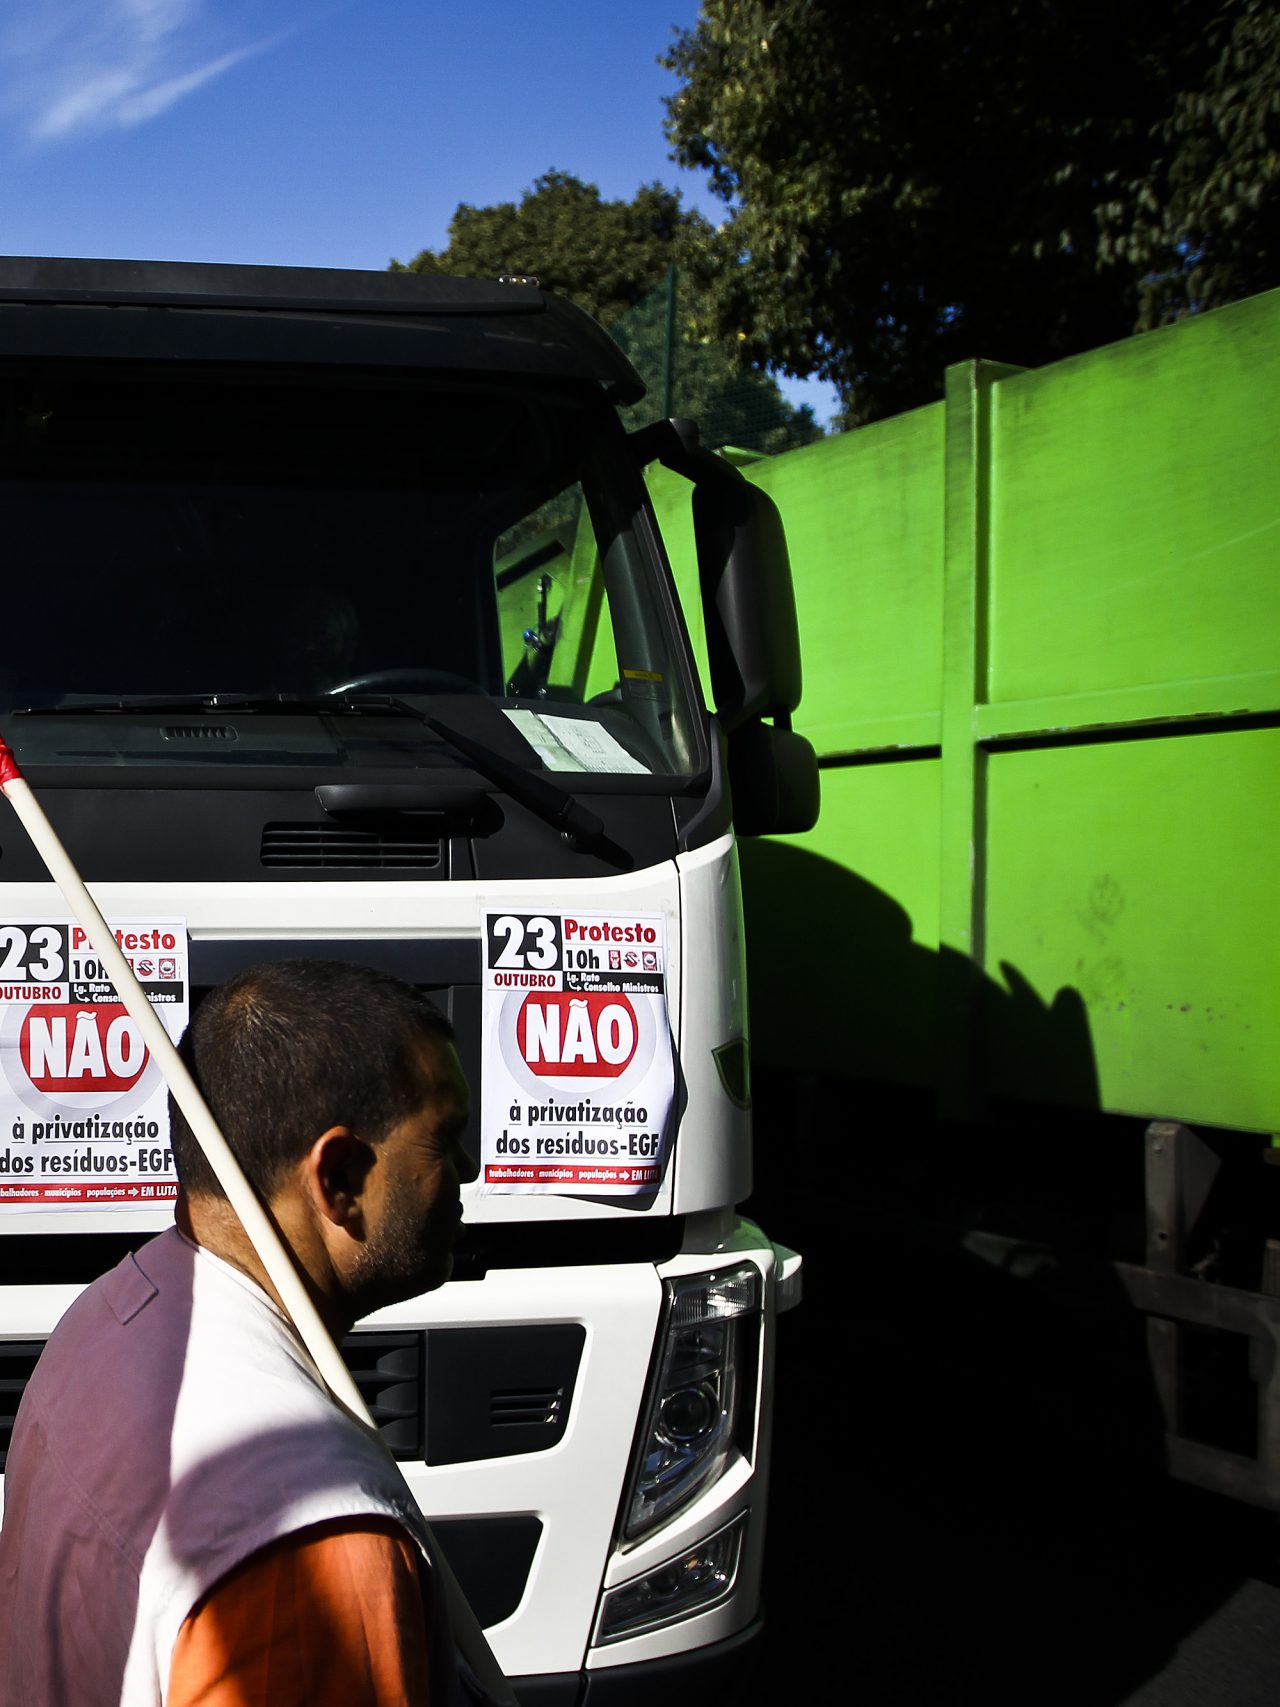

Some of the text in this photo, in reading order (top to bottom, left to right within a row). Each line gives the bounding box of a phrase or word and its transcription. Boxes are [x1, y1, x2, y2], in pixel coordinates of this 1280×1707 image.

[73, 927, 176, 950] Ptesto
[564, 919, 656, 943] Protesto
[493, 916, 558, 970] 23
[566, 949, 600, 969] 10h
[73, 983, 111, 994] Lg. Rato
[494, 973, 556, 987] OUTUBRO
[566, 972, 600, 983] Lg. Rato
[583, 982, 659, 993] Conselho Ministros
[525, 998, 634, 1065] NÃO
[29, 1010, 146, 1079] NÃO
[509, 1098, 648, 1130] à privatização
[12, 1114, 159, 1145] à privatização
[496, 1130, 659, 1156] dos resíduos-EGF
[41, 1147, 173, 1173] resíduos-EGF
[489, 1168, 534, 1179] trabalhadores
[538, 1168, 573, 1180] municípios
[578, 1169, 617, 1181] populações
[631, 1170, 643, 1181] EM
[44, 1187, 82, 1199] municípios
[87, 1187, 126, 1198] populações
[141, 1186, 154, 1197] EM
[156, 1185, 178, 1196] LUTA
